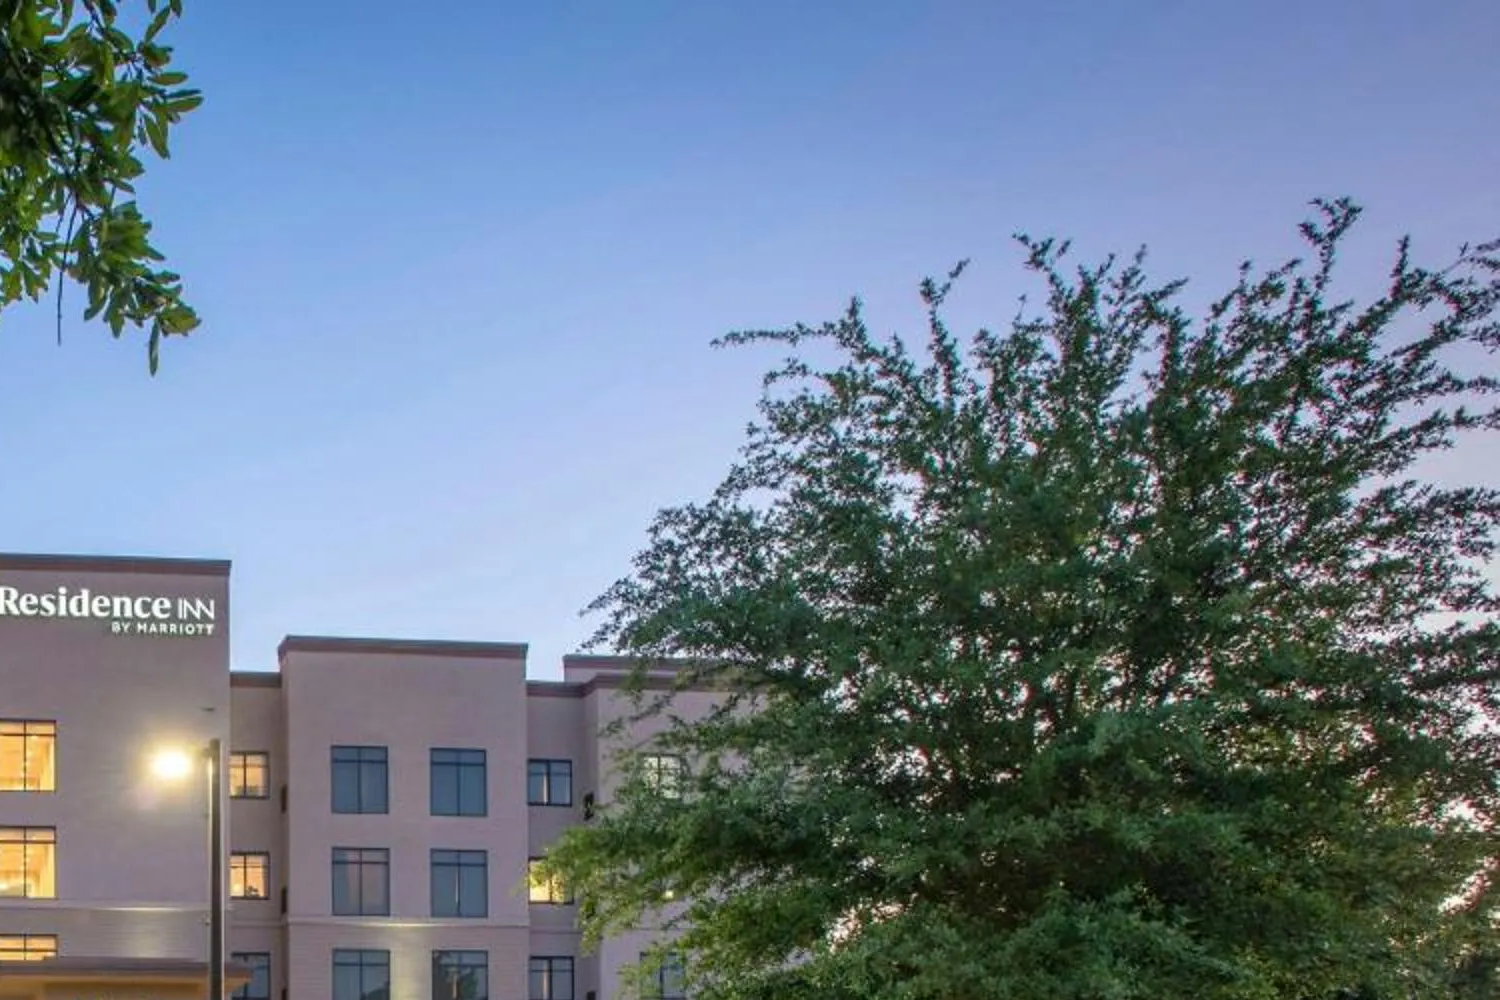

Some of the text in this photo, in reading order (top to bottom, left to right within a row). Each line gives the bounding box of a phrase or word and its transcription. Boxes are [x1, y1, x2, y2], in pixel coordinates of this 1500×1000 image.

[177, 598, 215, 620] INN
[111, 621, 215, 635] BY MARRIOTT
